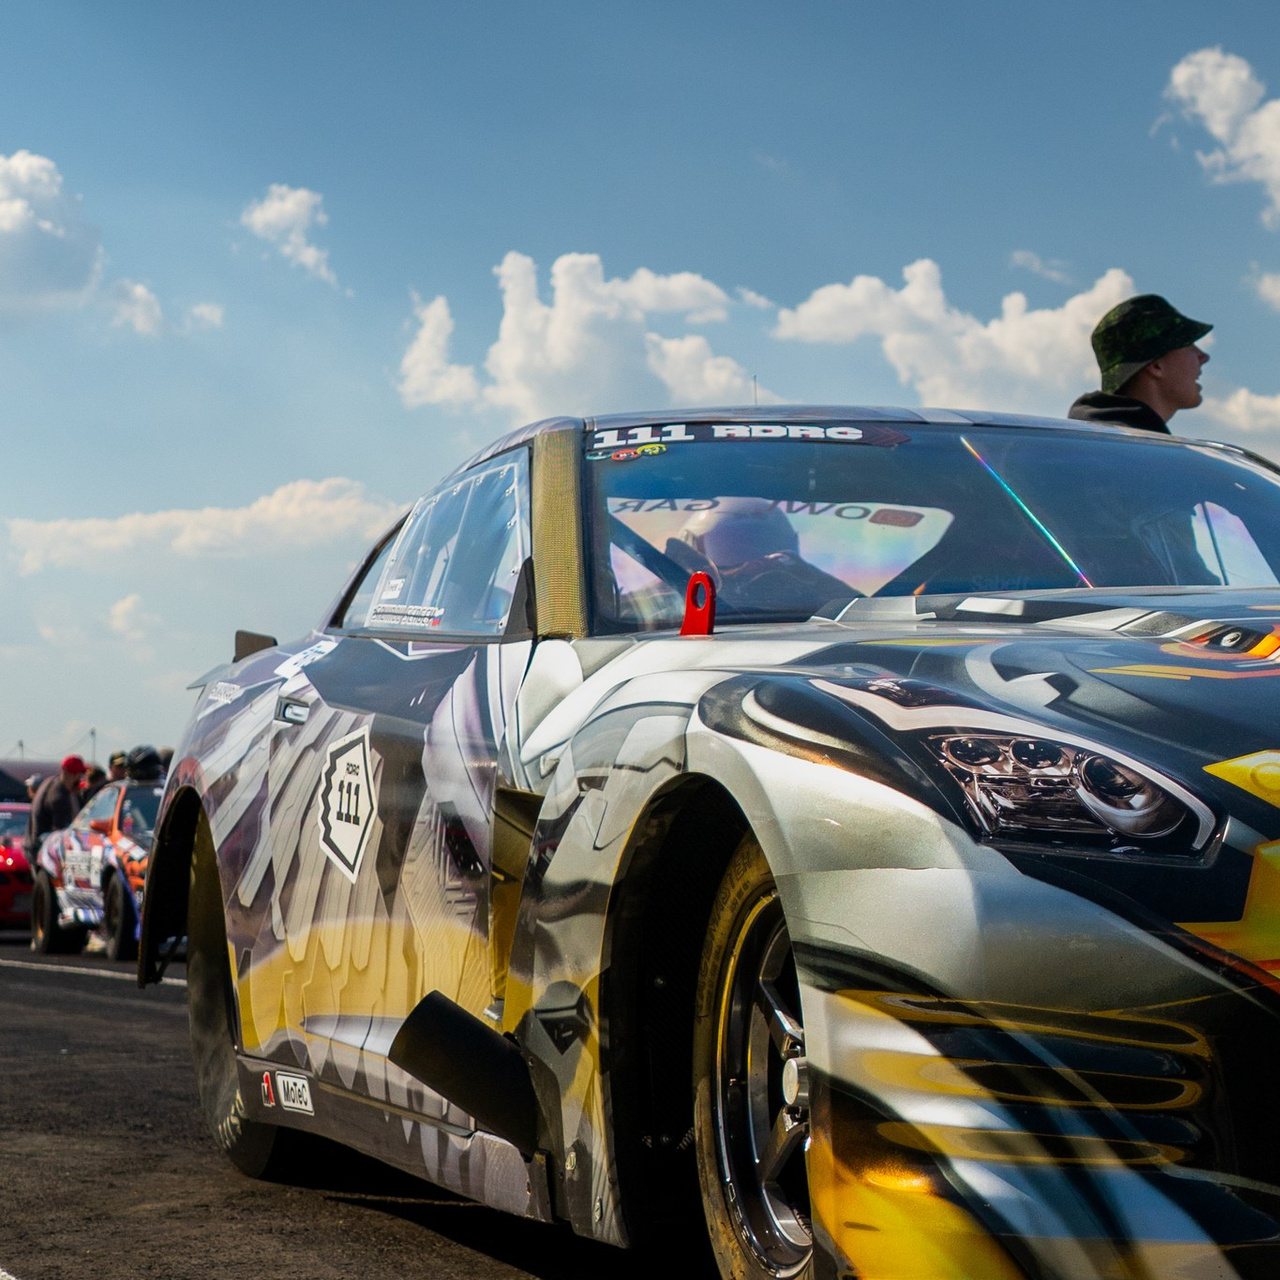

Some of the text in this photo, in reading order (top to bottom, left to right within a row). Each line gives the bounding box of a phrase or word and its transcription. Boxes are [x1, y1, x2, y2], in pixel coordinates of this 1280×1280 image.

[592, 424, 863, 449] 111 RDRC
[345, 761, 360, 776] RDRC
[336, 779, 361, 826] 111
[282, 1079, 308, 1107] MoTeC
